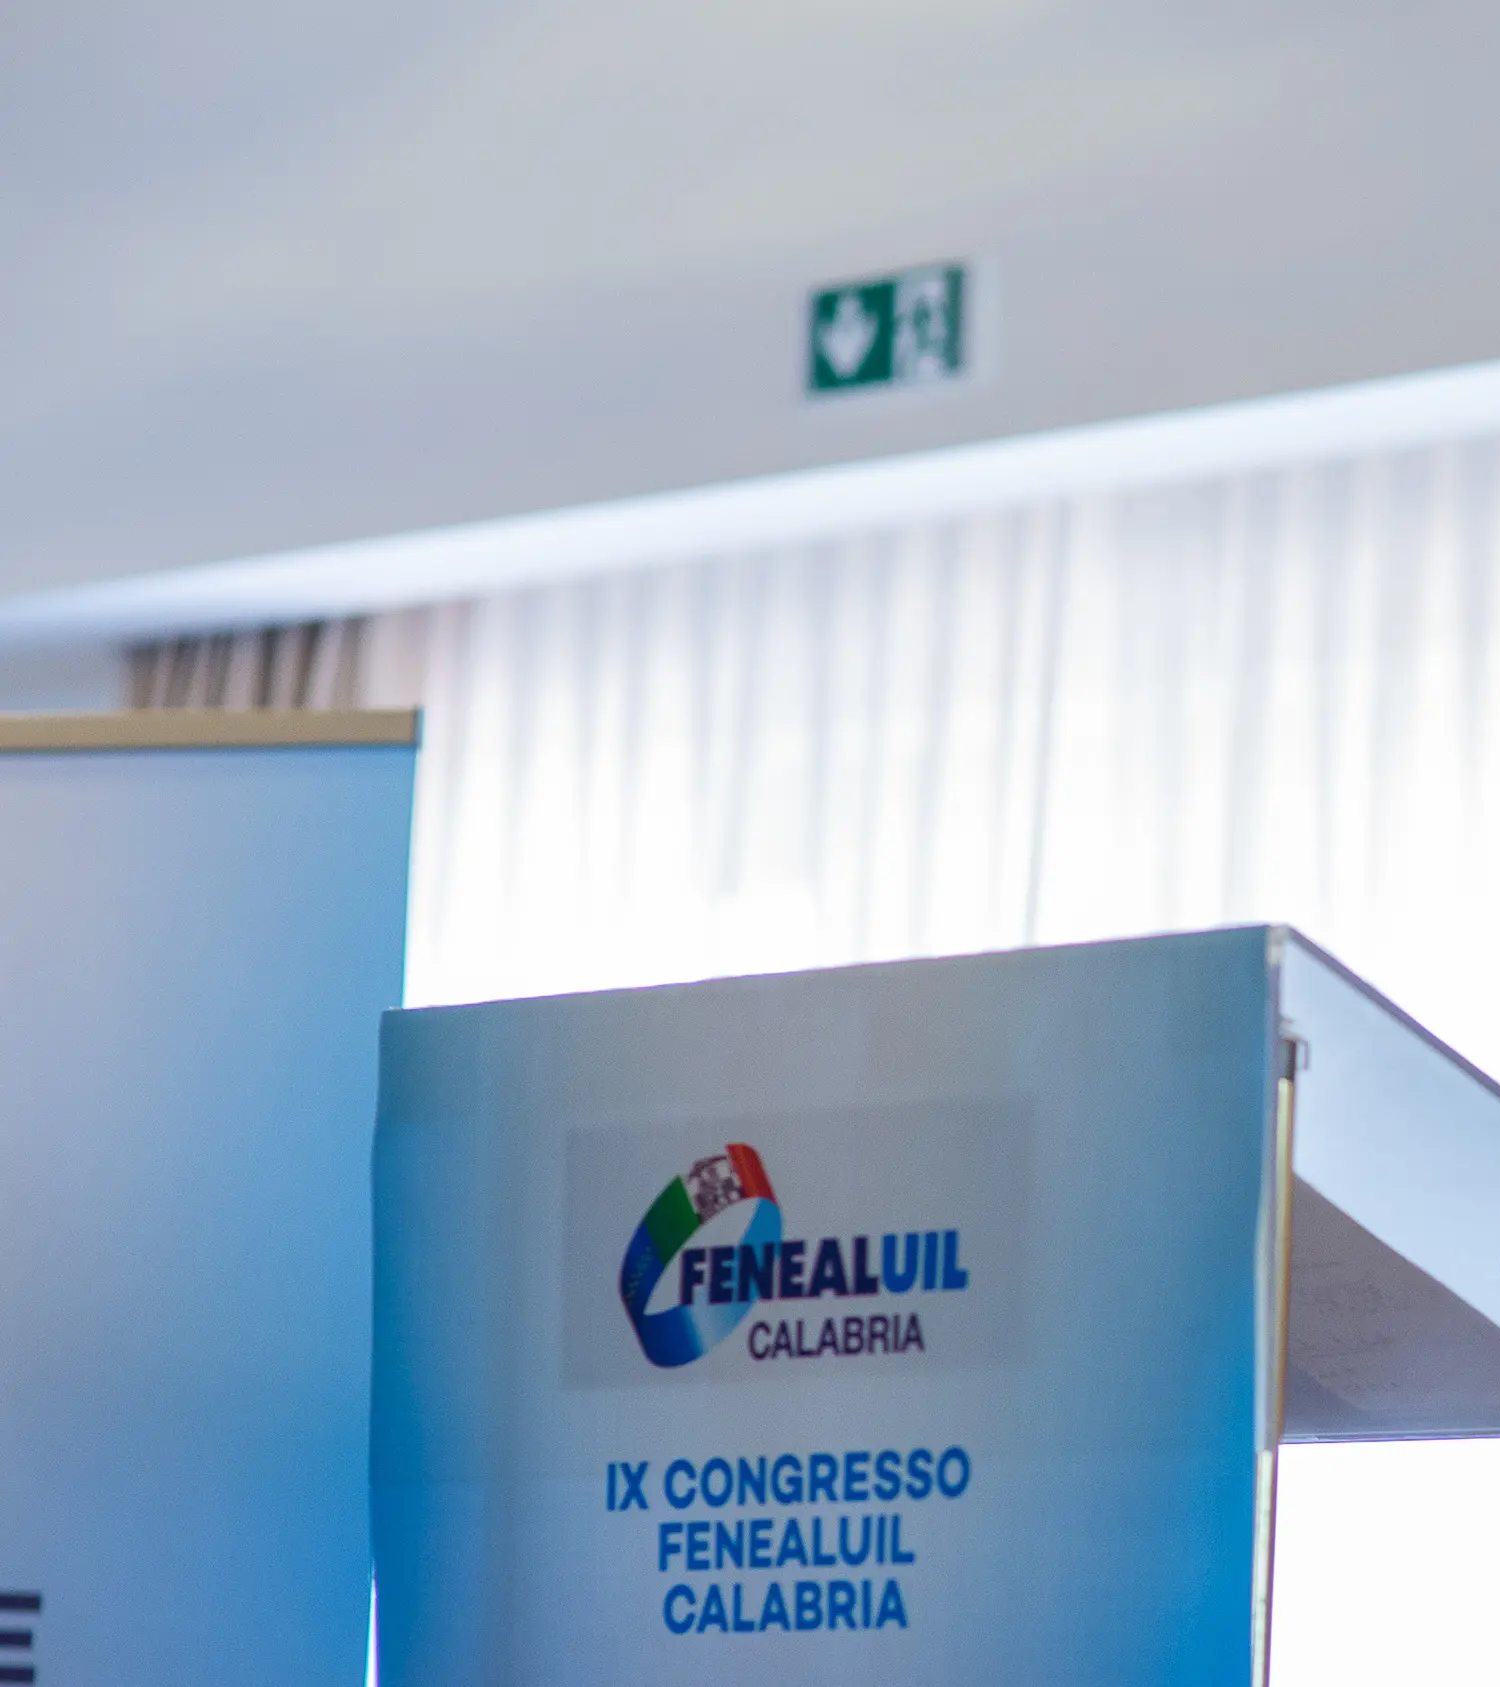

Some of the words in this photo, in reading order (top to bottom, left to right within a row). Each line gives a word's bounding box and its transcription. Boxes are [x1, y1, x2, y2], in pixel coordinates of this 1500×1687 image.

[681, 1229, 969, 1306] FENEALUIL
[748, 1313, 925, 1360] CALABRIA
[606, 1461, 650, 1511] IX
[664, 1446, 971, 1509] CONGRESSO
[657, 1514, 916, 1571] FENEALUIL
[663, 1578, 908, 1634] CALABRIA
